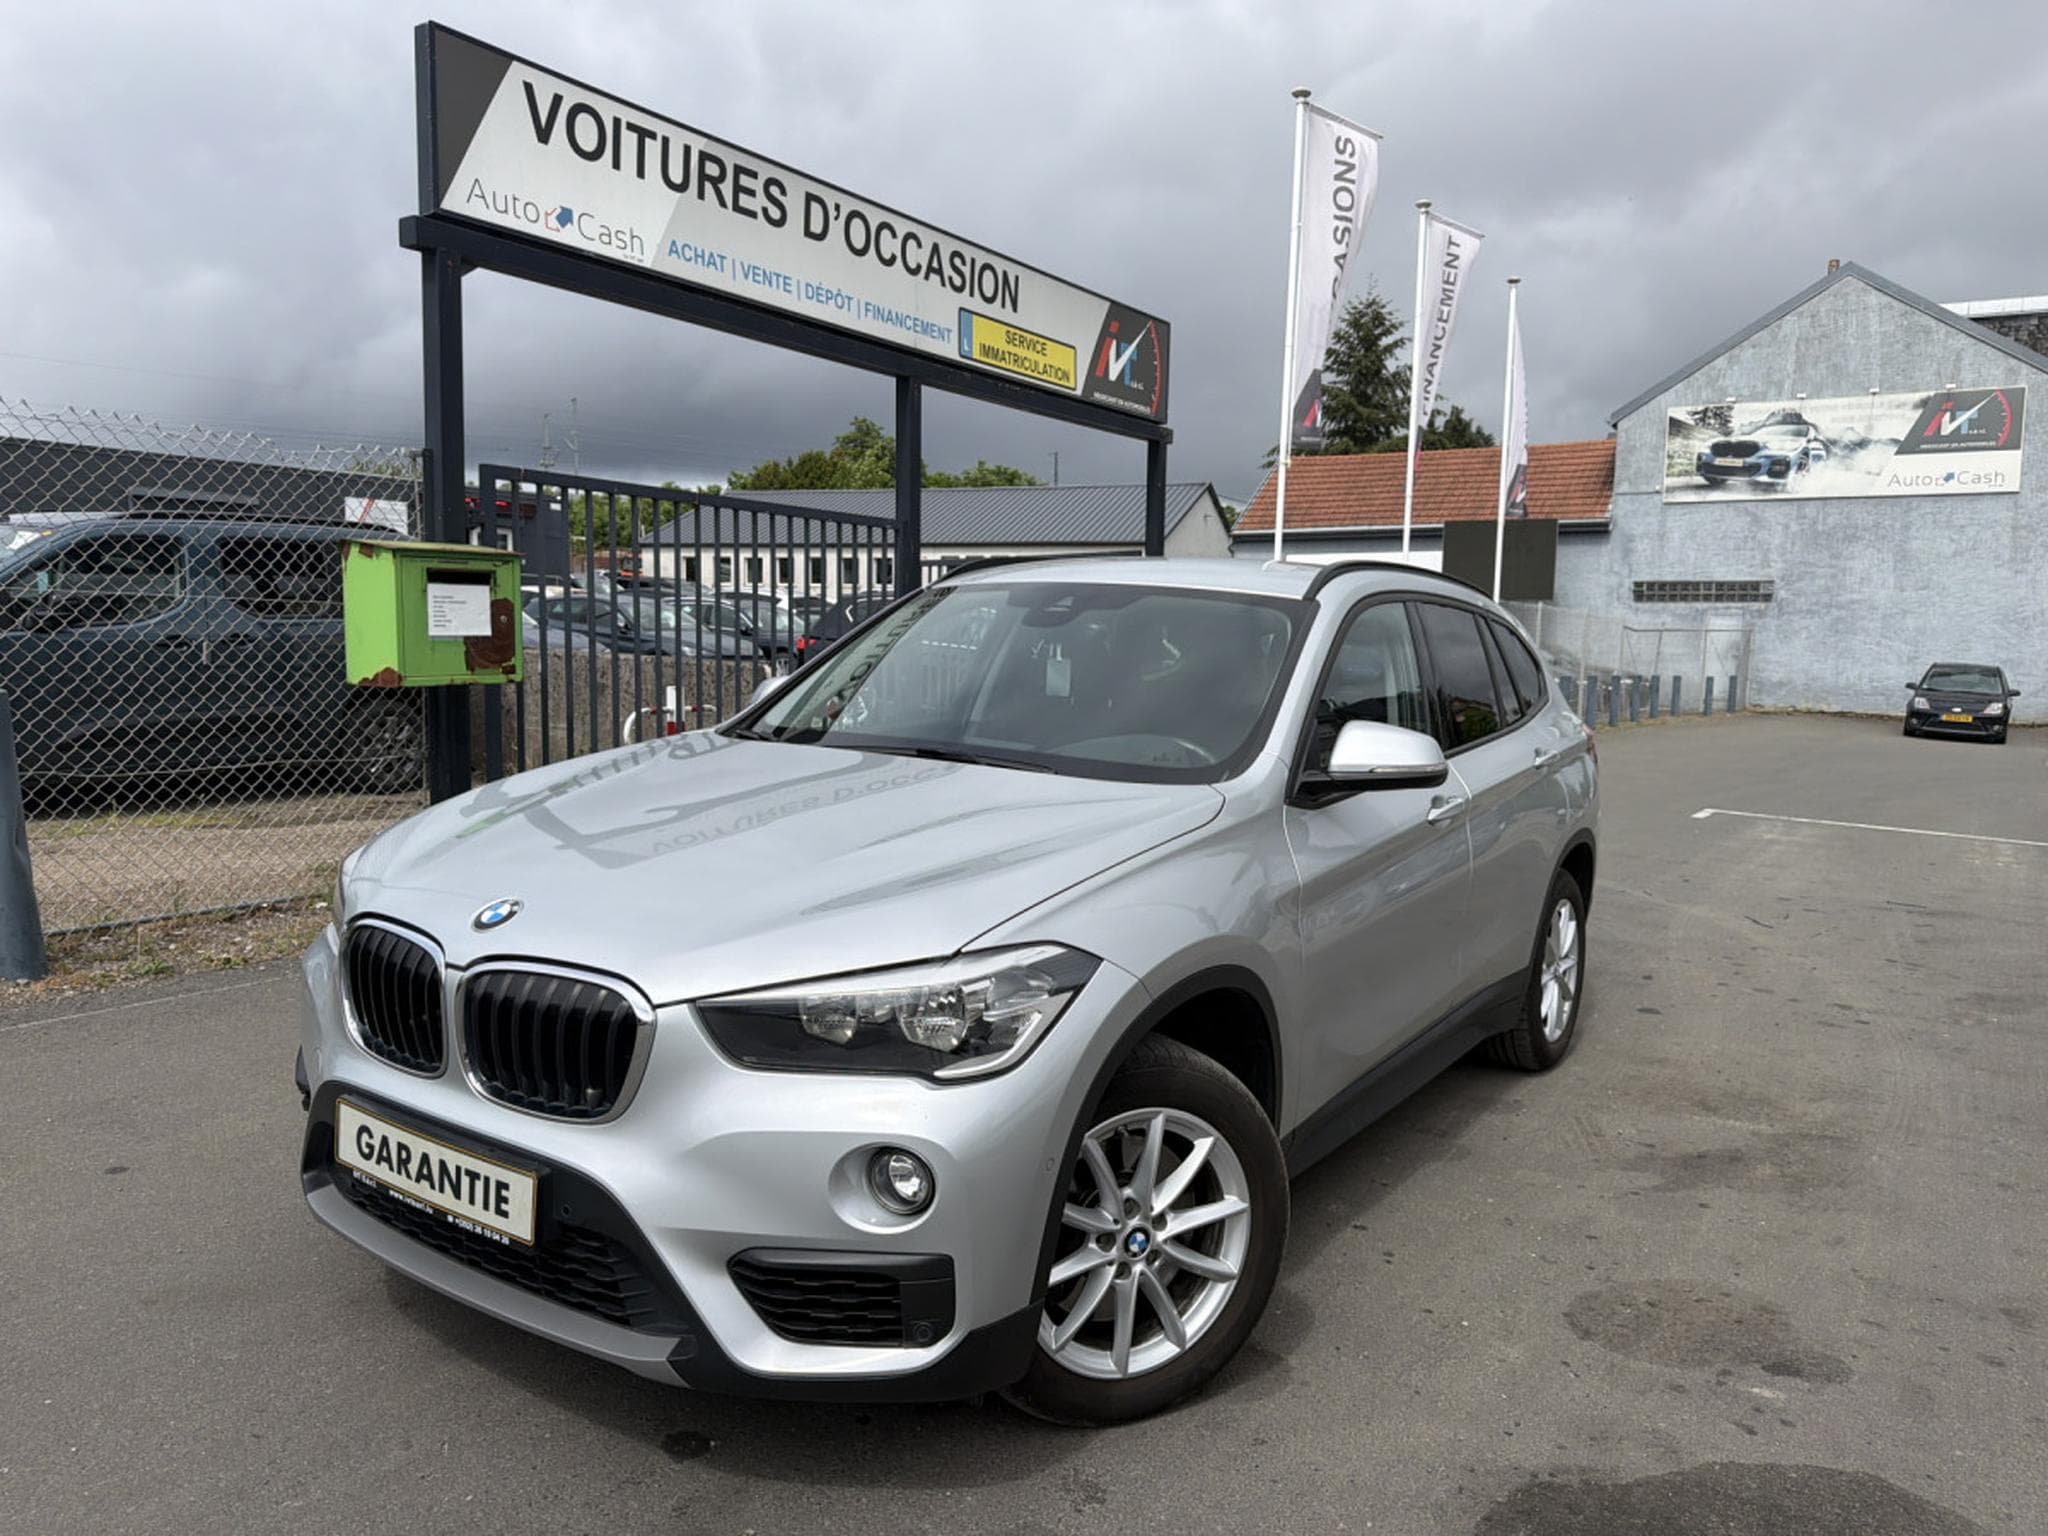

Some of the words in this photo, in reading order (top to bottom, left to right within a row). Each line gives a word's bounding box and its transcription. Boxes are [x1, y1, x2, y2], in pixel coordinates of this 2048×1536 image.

[466, 178, 541, 224] Auto
[577, 212, 644, 256] Cash
[522, 80, 788, 228] VOITURES
[803, 191, 1020, 313] D'OCCASION
[668, 239, 727, 273] ACHAT
[740, 261, 792, 294] VENTE
[805, 281, 853, 312] DÉPÔT
[864, 301, 953, 343] FINANCEMENT
[979, 342, 1070, 382] IMMATRICULATION
[1004, 330, 1048, 357] SERVICE
[1887, 473, 1933, 488] Auto
[1956, 471, 2005, 485] Cash
[356, 1124, 511, 1219] GARANTIE
